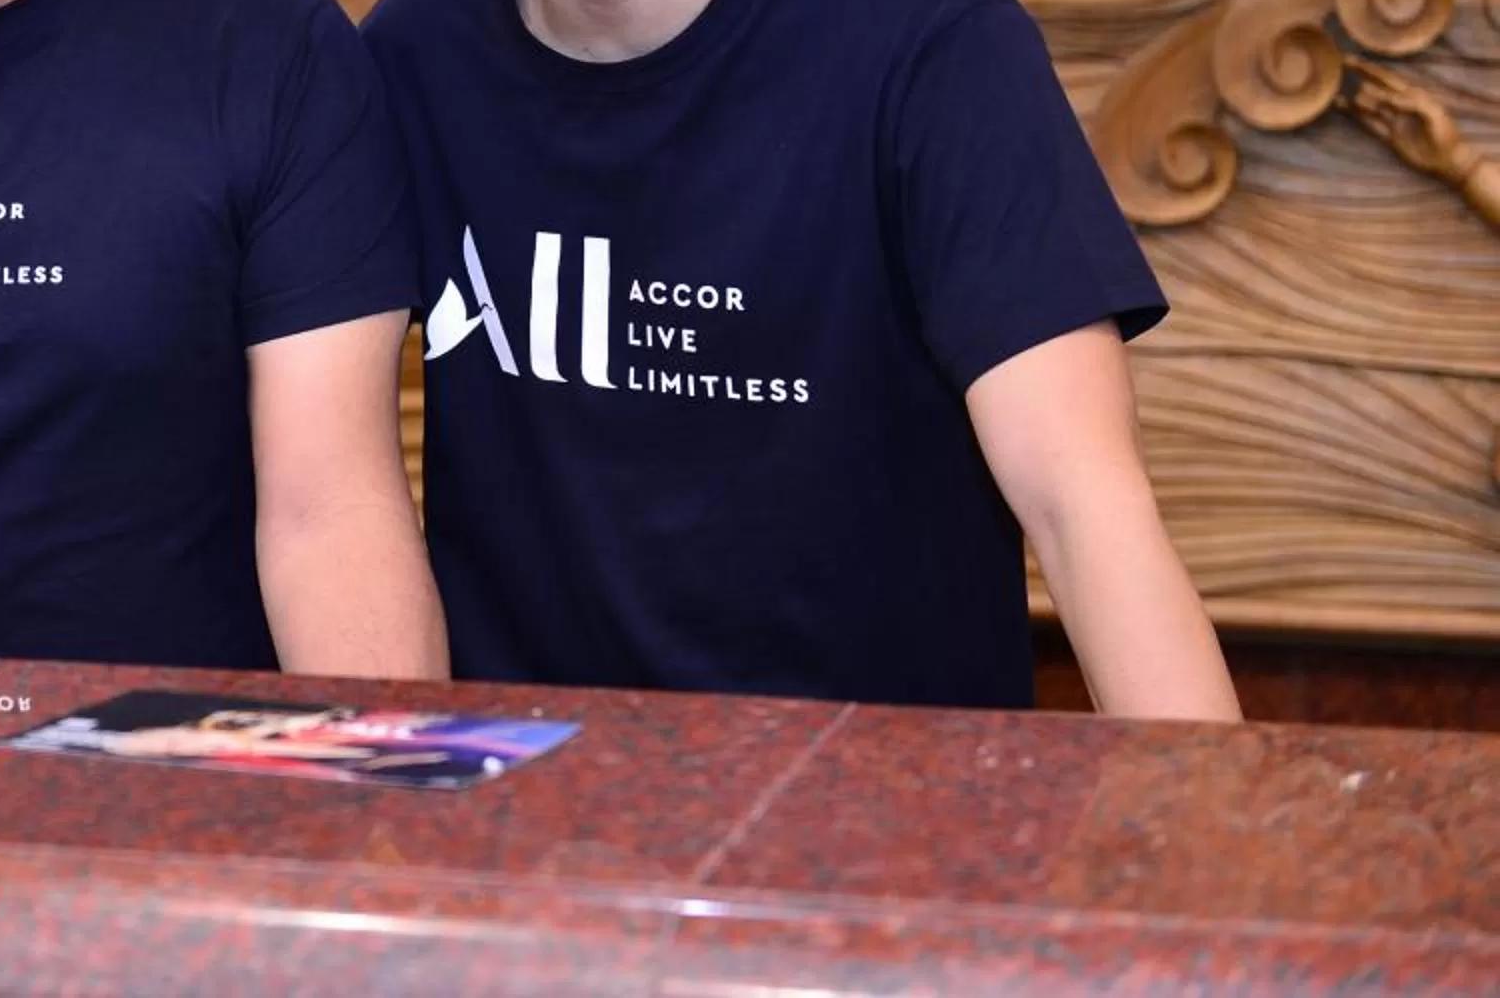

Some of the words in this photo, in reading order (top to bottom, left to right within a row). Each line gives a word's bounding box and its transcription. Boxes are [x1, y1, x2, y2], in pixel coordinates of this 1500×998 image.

[630, 280, 744, 310] ACCOR
[628, 323, 696, 352] LIVE
[629, 367, 808, 402] LIMITLESS
